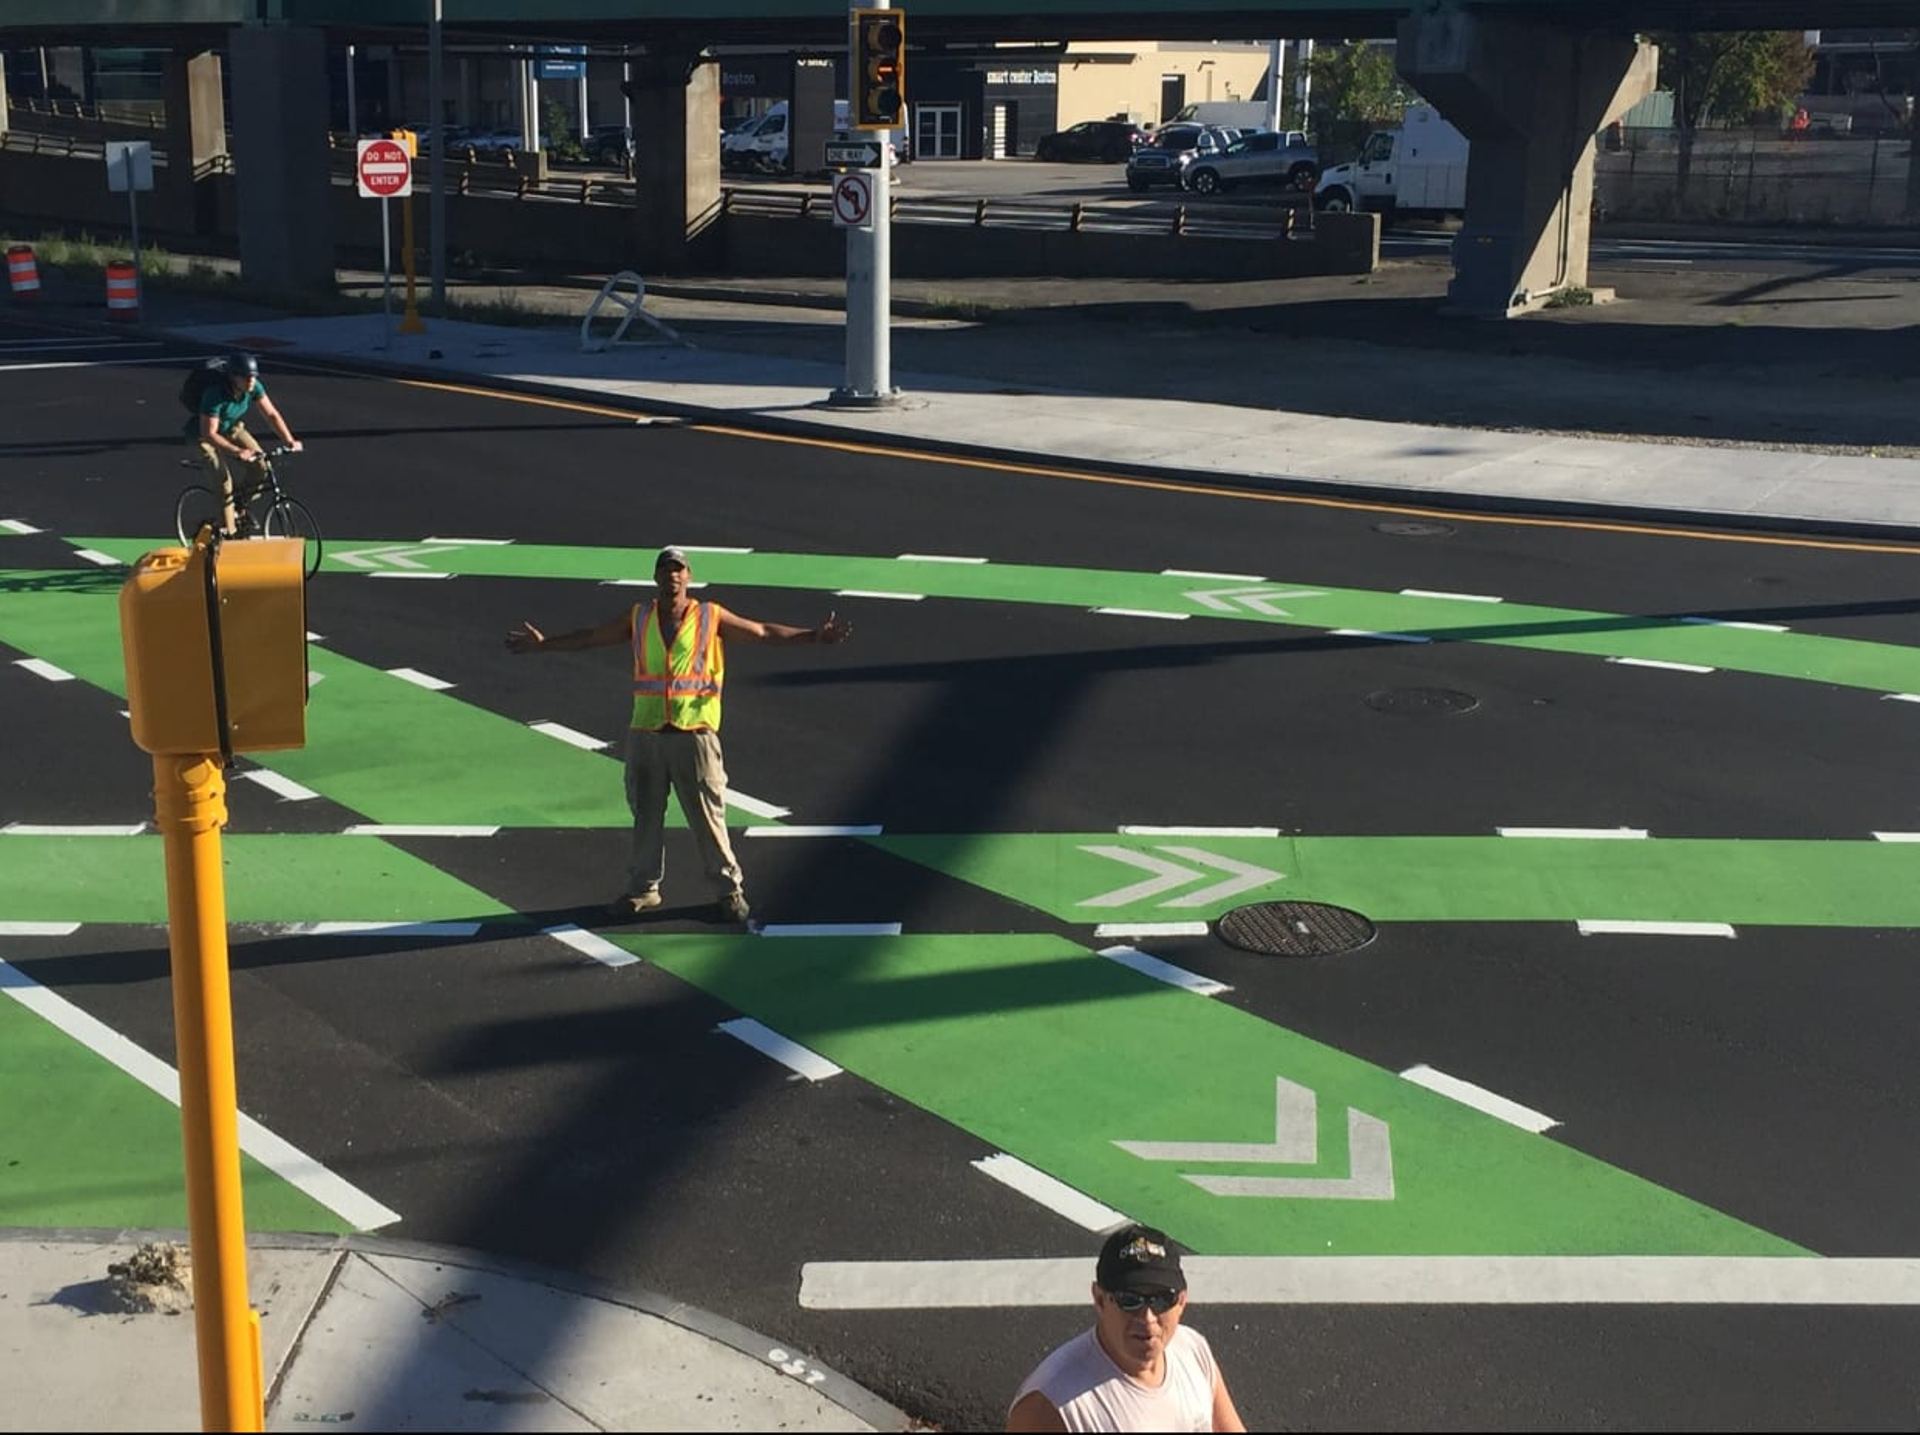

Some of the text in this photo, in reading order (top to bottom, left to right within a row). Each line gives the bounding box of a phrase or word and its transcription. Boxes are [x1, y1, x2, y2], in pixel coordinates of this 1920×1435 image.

[366, 151, 402, 161] DO NOT
[830, 149, 863, 160] ONE WAY
[370, 175, 399, 186] ENTER
